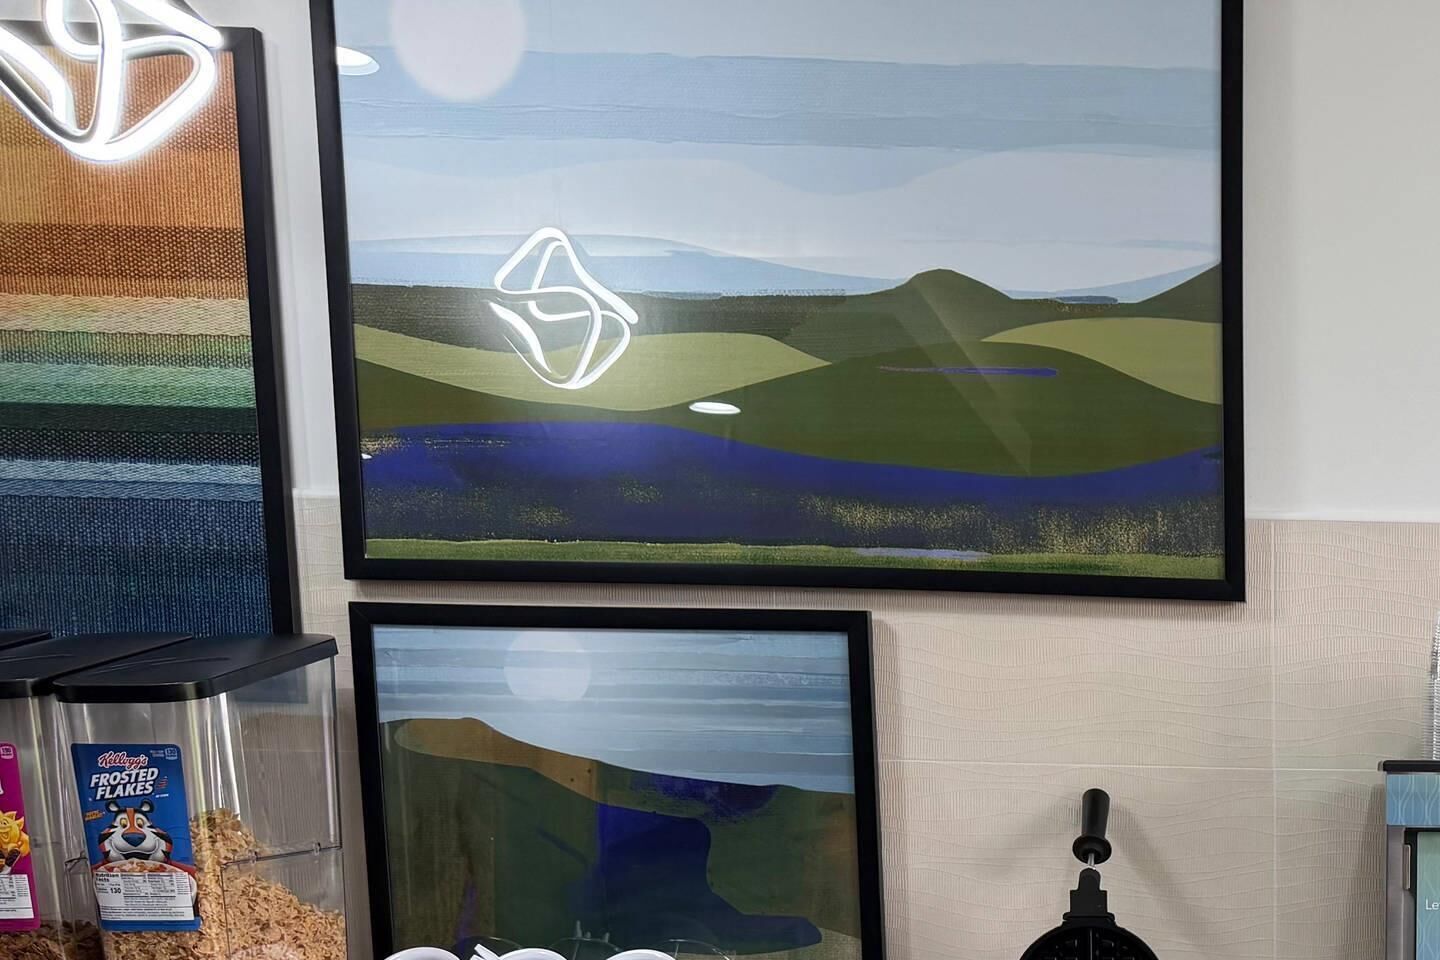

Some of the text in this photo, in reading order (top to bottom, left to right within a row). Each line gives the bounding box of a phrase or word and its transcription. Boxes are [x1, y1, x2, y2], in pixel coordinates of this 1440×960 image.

[98, 751, 148, 770] Kellogg's
[90, 767, 159, 788] FROSTED
[96, 780, 153, 800] FLAKES
